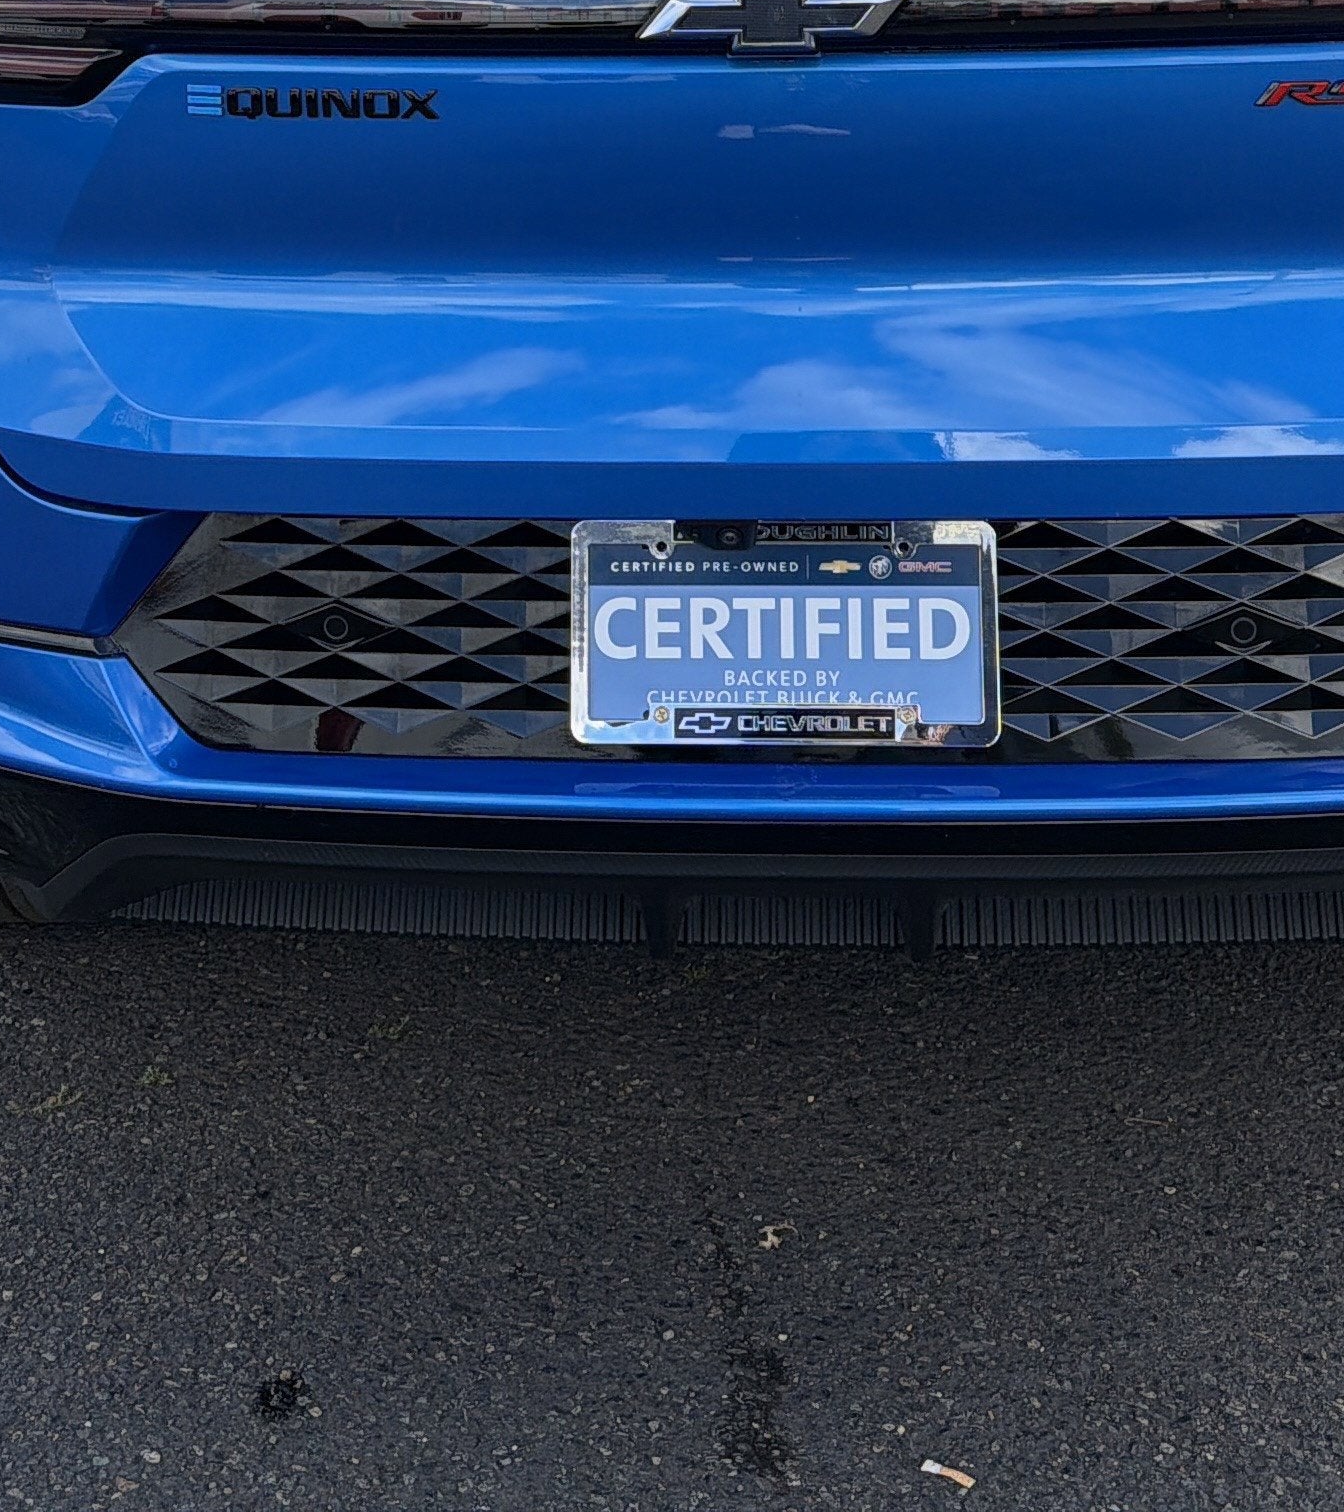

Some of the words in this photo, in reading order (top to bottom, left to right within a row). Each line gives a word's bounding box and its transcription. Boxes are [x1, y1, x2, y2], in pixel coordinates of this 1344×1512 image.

[186, 84, 440, 120] EQUINOX
[676, 524, 891, 540] OUGHLIN
[610, 561, 695, 573] CERTIFIED
[702, 561, 799, 573] PRE-OWNED
[898, 561, 953, 573] GMC
[594, 597, 971, 661] CERTIFIED
[724, 670, 806, 687] BACKED
[816, 670, 840, 687] BY
[849, 691, 862, 703] &
[871, 691, 919, 703] GMC
[737, 715, 893, 733] CHEVROLET
